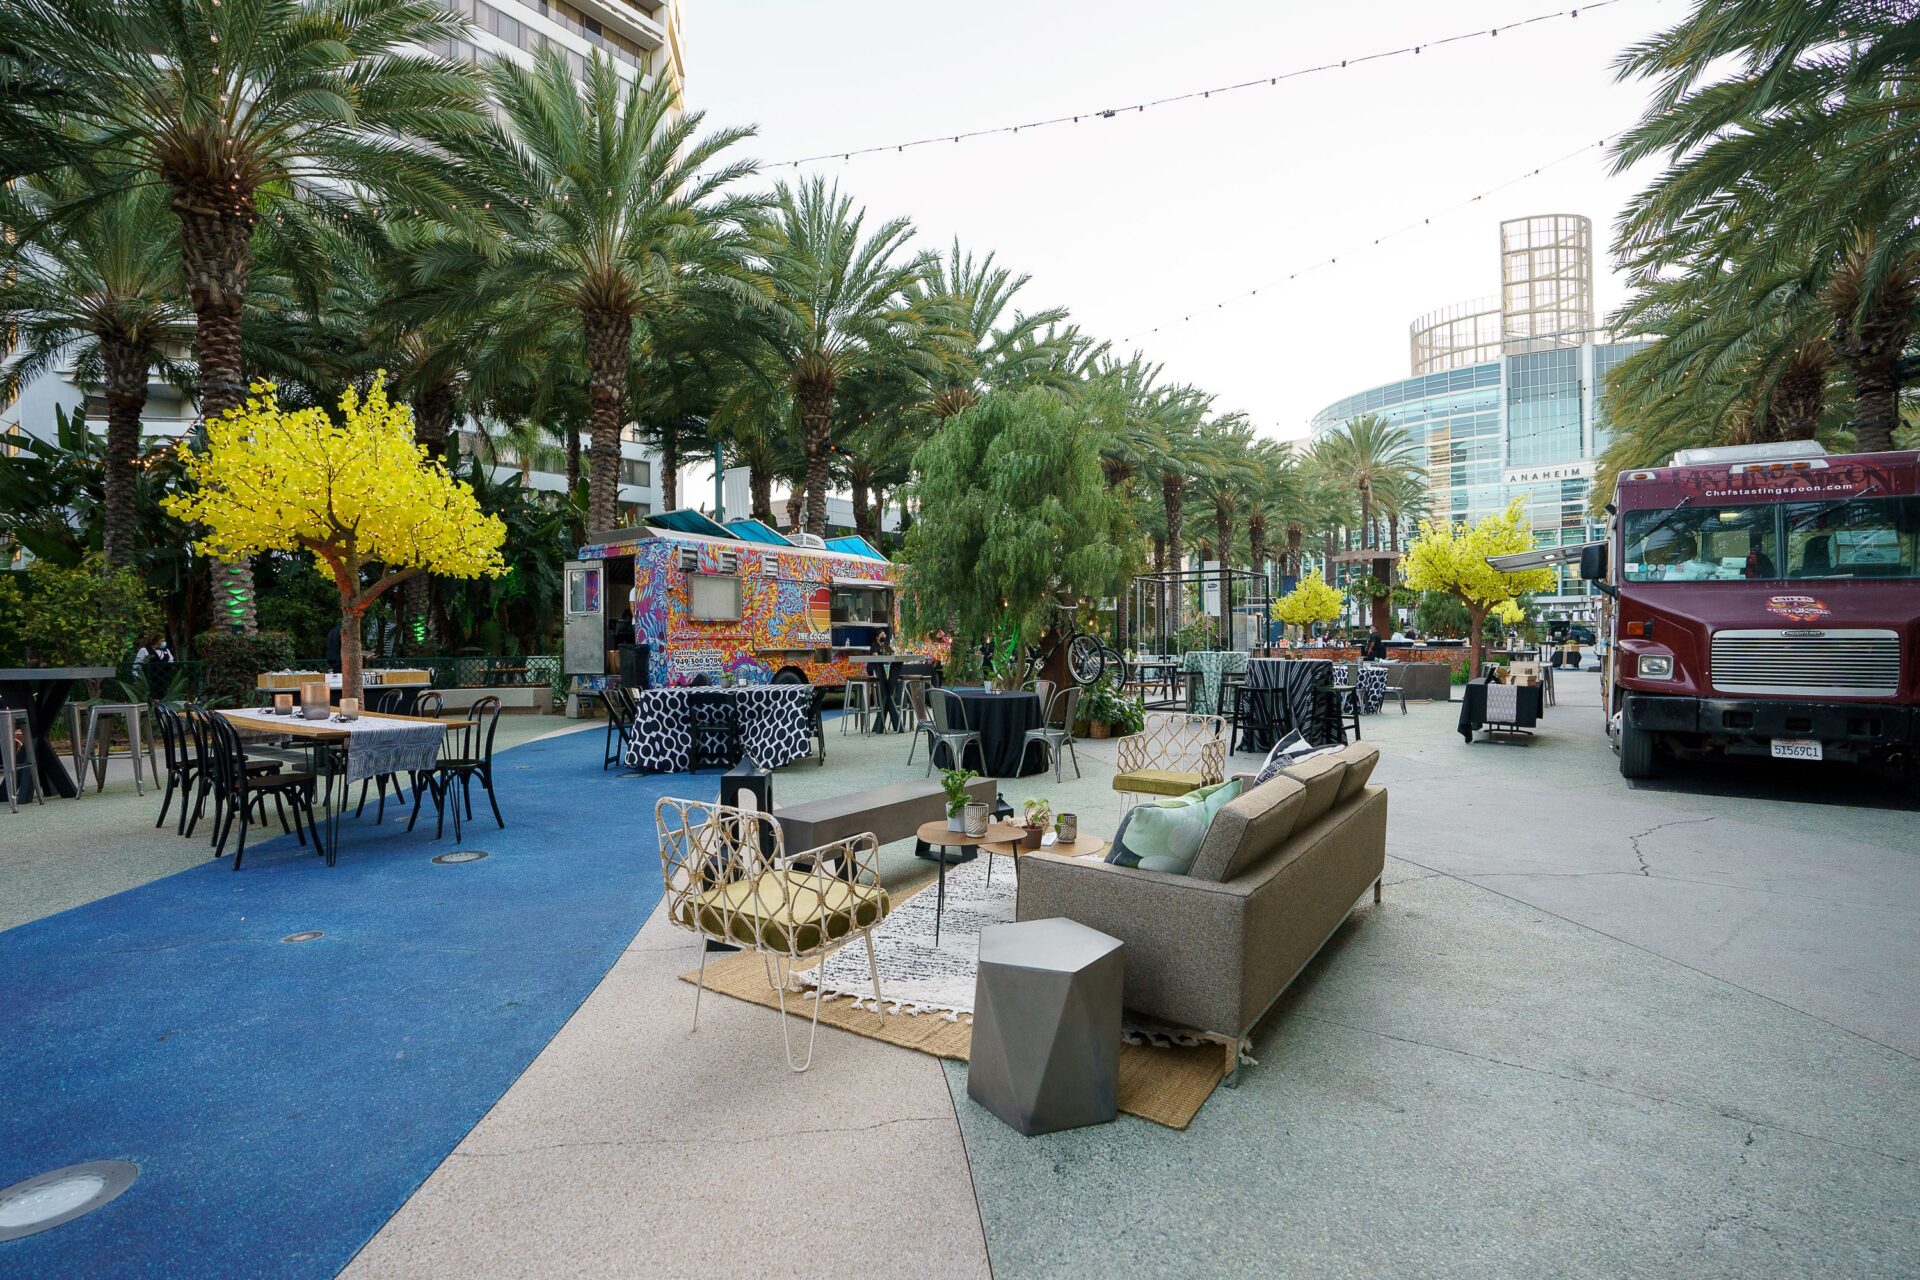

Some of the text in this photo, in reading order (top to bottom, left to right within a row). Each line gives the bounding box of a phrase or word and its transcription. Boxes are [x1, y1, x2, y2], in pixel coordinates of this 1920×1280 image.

[1510, 468, 1580, 482] ANAHEIM
[1705, 483, 1853, 497] Chefstastingspoon.com
[1774, 745, 1820, 757] 51569C1
